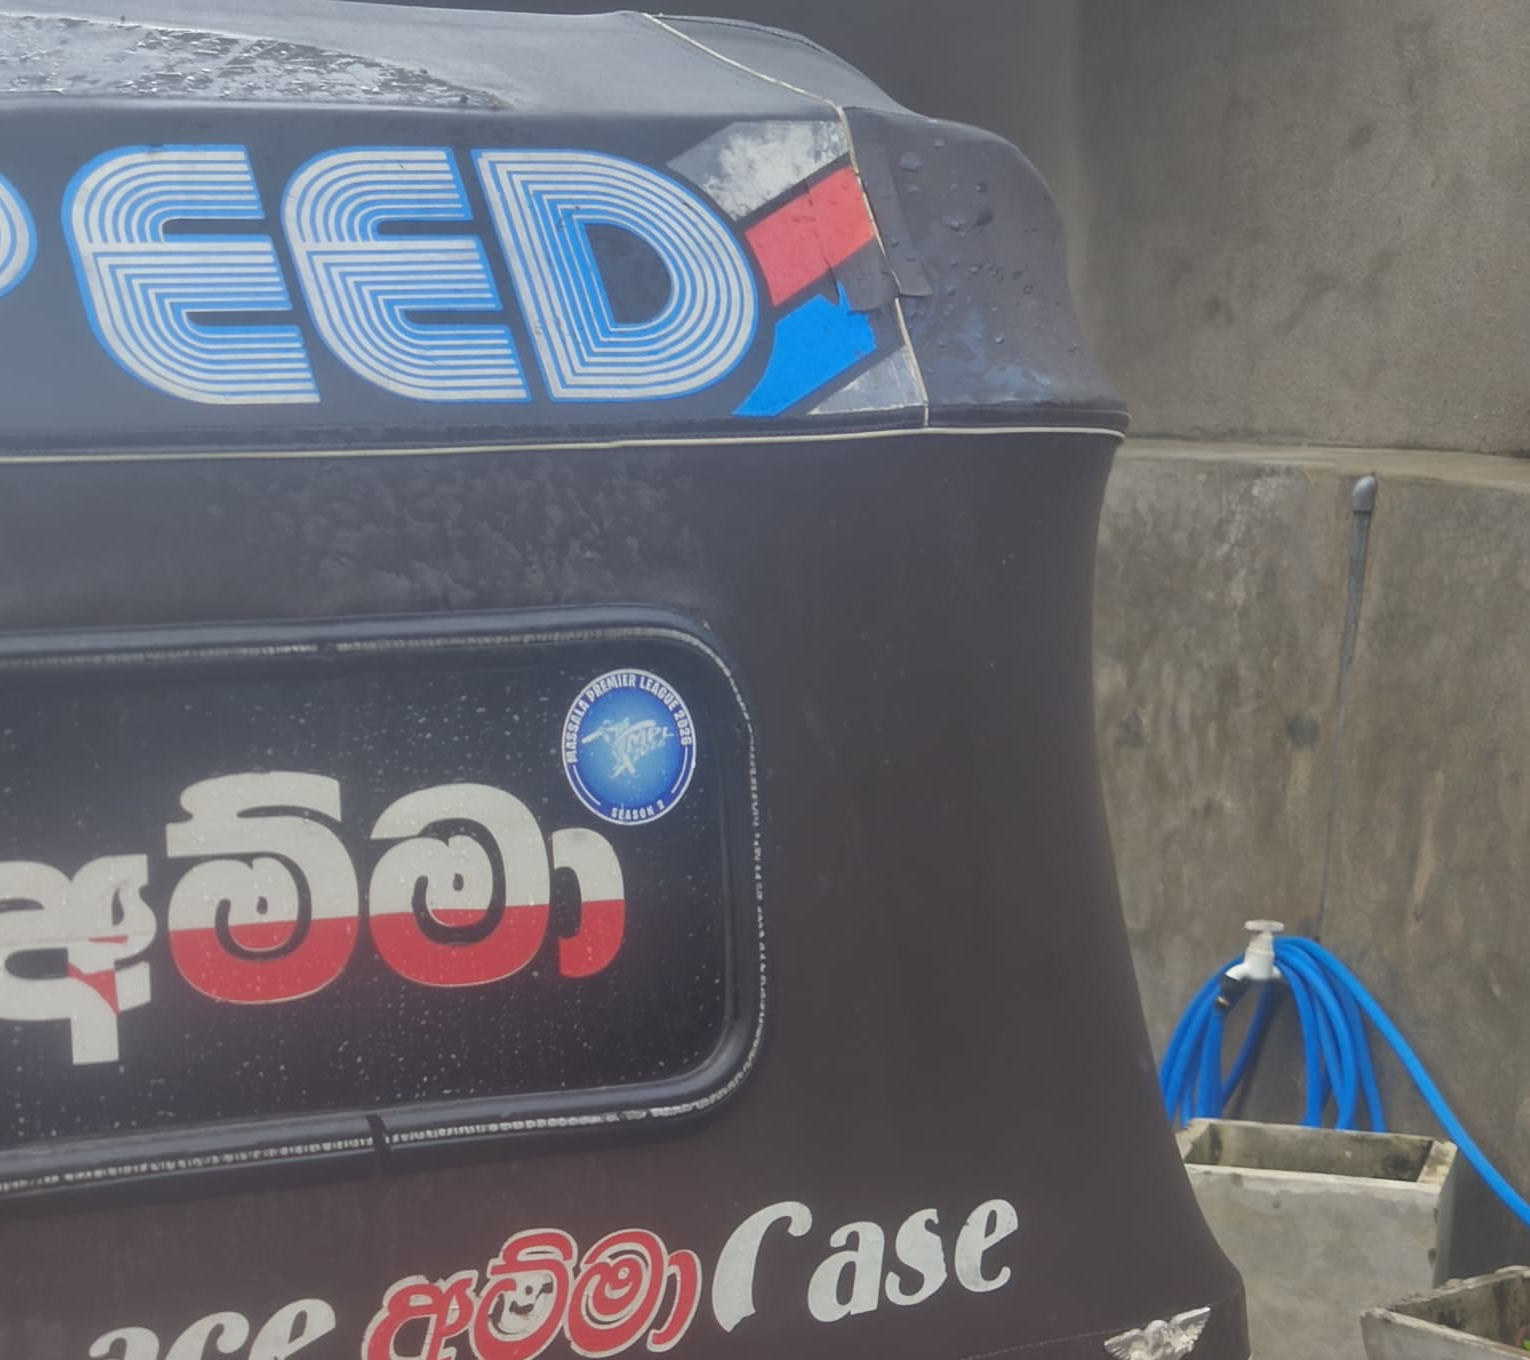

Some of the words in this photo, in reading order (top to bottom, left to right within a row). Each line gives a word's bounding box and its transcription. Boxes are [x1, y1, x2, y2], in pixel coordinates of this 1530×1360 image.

[566, 700, 590, 763] MASSALA
[586, 674, 636, 702] PREMIER
[639, 676, 678, 711] LEAGUE
[674, 711, 692, 746] 2026
[611, 806, 655, 821] SEASON
[656, 799, 665, 810] 2
